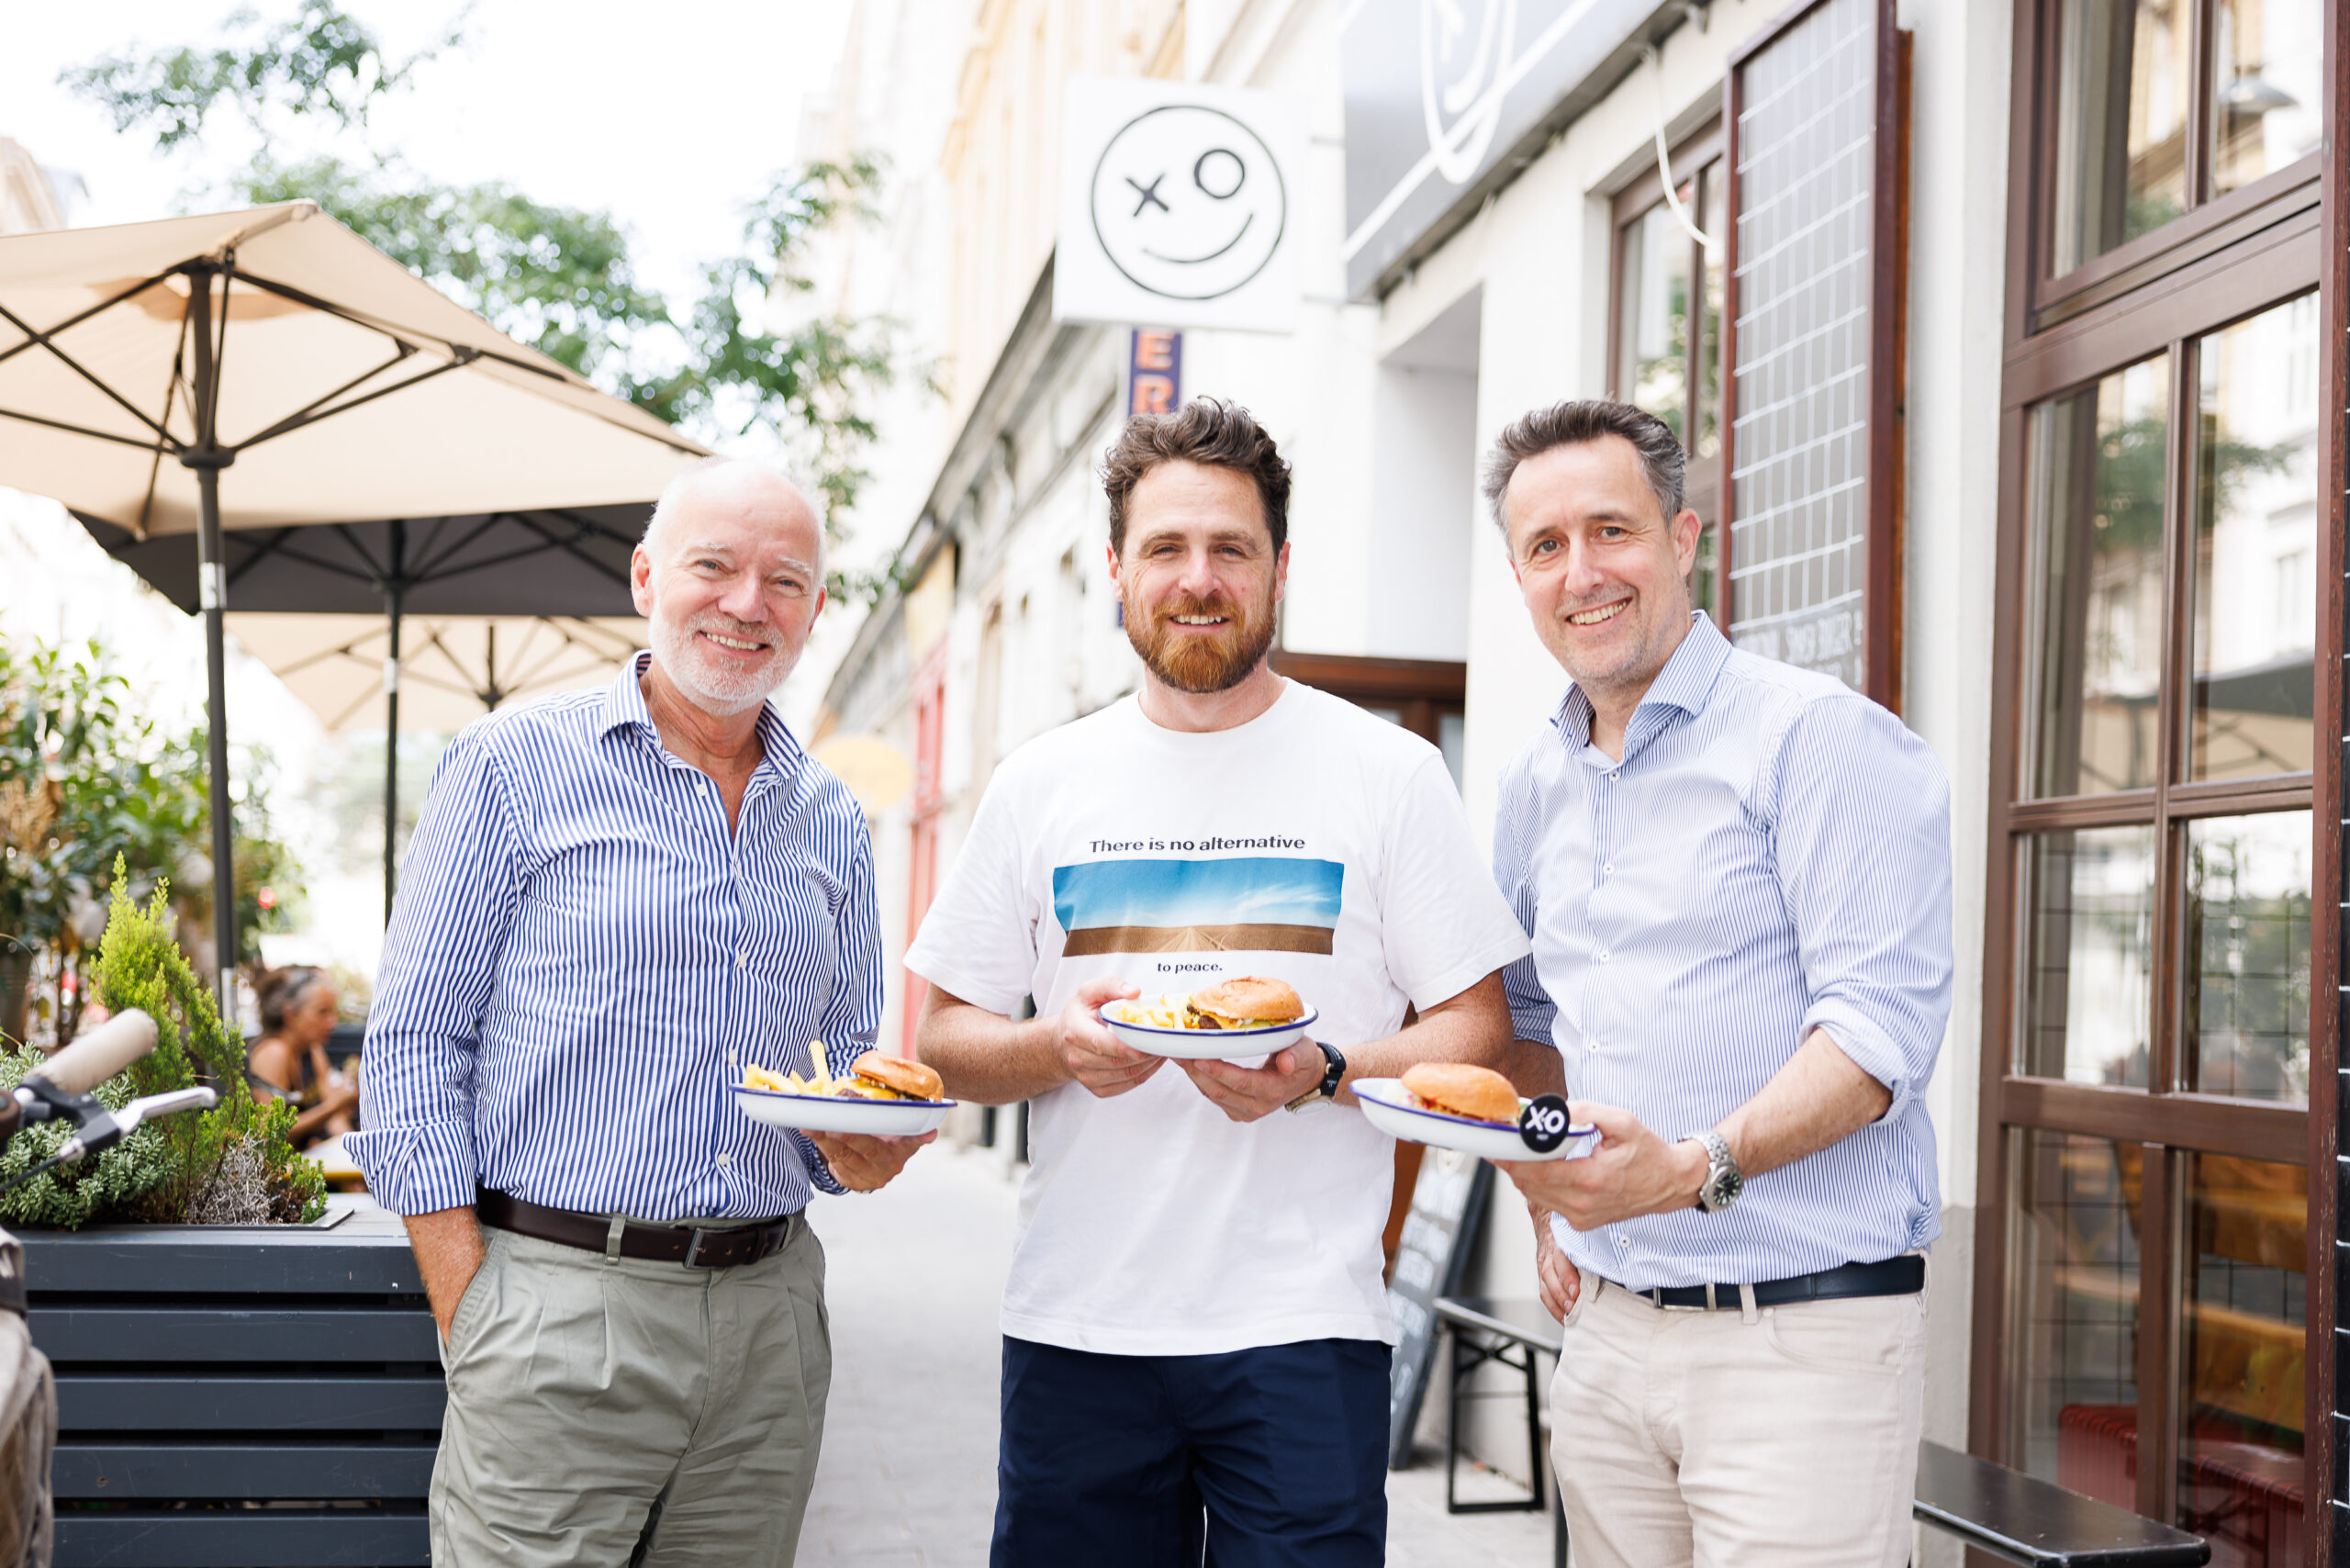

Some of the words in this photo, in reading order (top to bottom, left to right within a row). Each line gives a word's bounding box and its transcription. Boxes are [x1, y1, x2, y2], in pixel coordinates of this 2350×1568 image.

[1090, 839, 1145, 853] There
[1148, 837, 1166, 851] is
[1169, 840, 1195, 851] no
[1199, 834, 1305, 851] alternative
[1157, 962, 1171, 973] to
[1174, 964, 1223, 975] peace.
